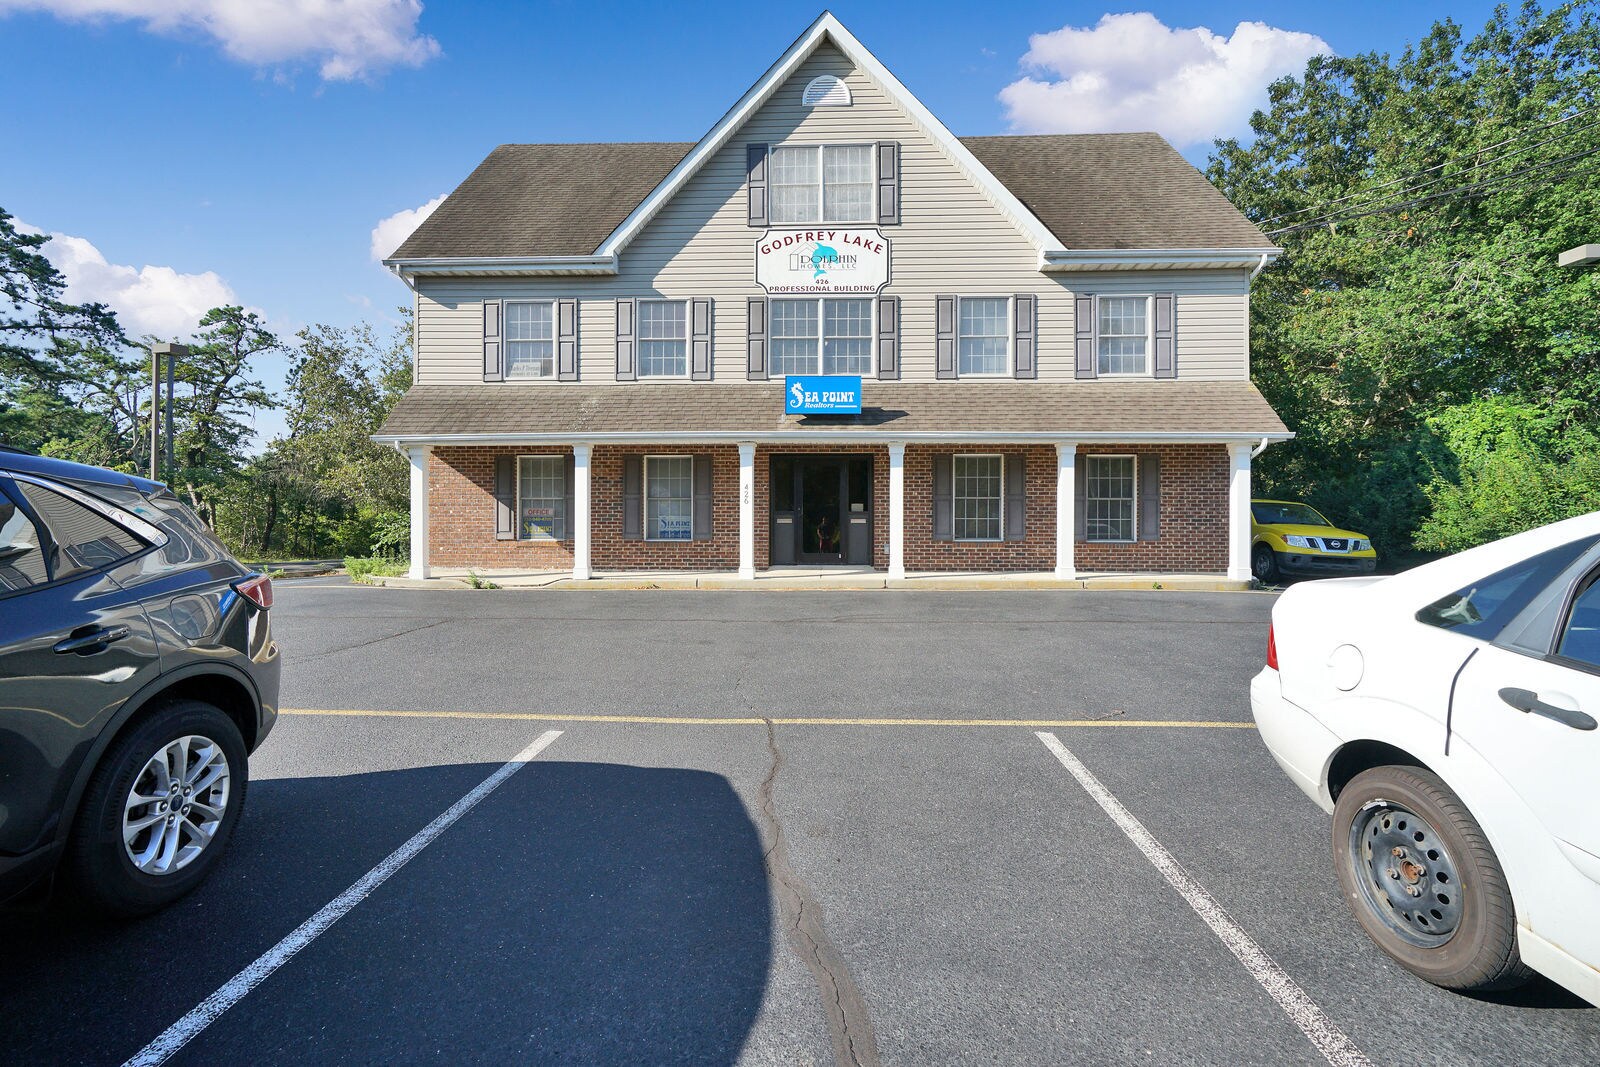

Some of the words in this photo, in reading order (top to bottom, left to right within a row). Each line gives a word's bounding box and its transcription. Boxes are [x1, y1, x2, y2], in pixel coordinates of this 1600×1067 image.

[761, 231, 836, 255] GODFREY
[843, 233, 884, 255] LAKE
[800, 254, 857, 264] DOLPHIN
[822, 391, 855, 403] POINT
